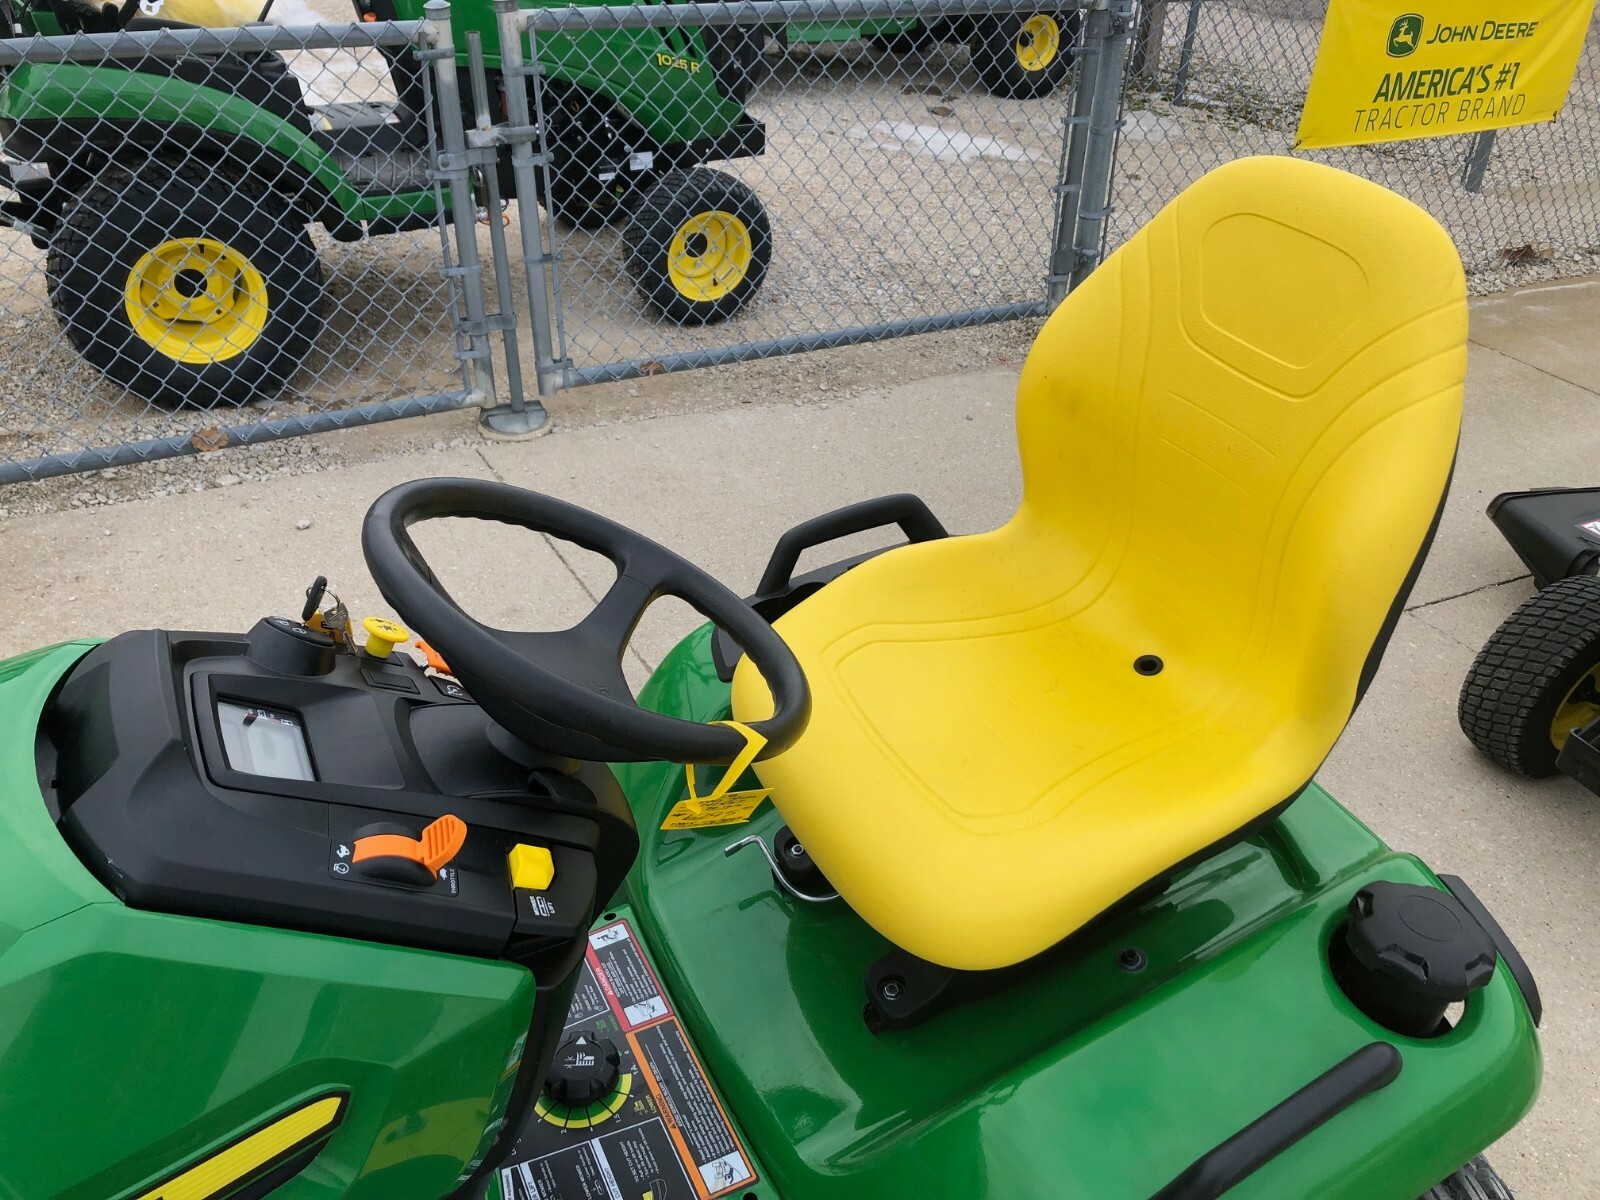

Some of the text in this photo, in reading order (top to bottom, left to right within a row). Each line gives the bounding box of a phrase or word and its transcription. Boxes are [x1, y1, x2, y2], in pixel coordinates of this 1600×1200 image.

[1426, 21, 1539, 45] JOHN DEERE
[656, 53, 700, 73] 1025 R
[1372, 62, 1520, 103] AMERICA'S #1
[1354, 94, 1526, 133] TRACTOR BRAND
[547, 901, 555, 914] LIFT
[595, 966, 610, 991] DANGER
[645, 1094, 656, 1114] LOWER
[655, 1093, 673, 1124] WARNING
[603, 1166, 620, 1198] CUT HEIGHT
